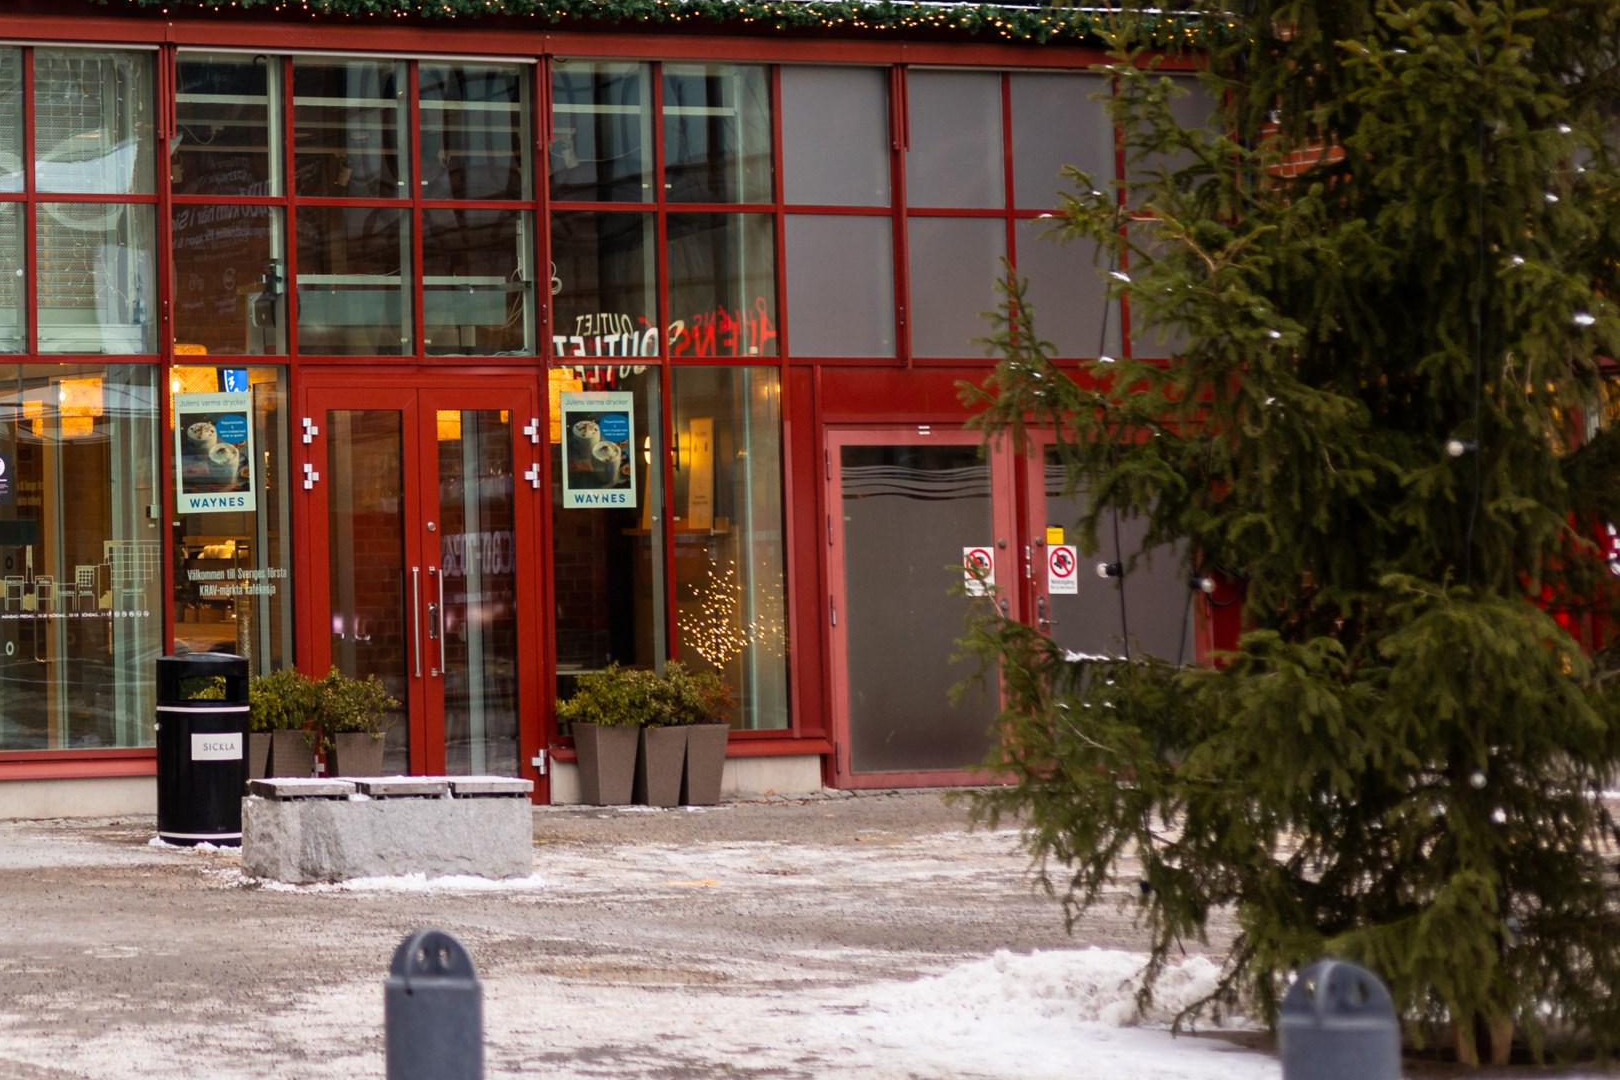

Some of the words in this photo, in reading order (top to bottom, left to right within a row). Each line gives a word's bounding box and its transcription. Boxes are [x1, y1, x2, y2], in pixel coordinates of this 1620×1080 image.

[190, 496, 244, 508] WAYNES
[574, 493, 626, 503] WAYNES
[187, 568, 224, 581] Välkommen
[237, 567, 266, 581] Sveriges
[202, 742, 235, 752] SICKLA
